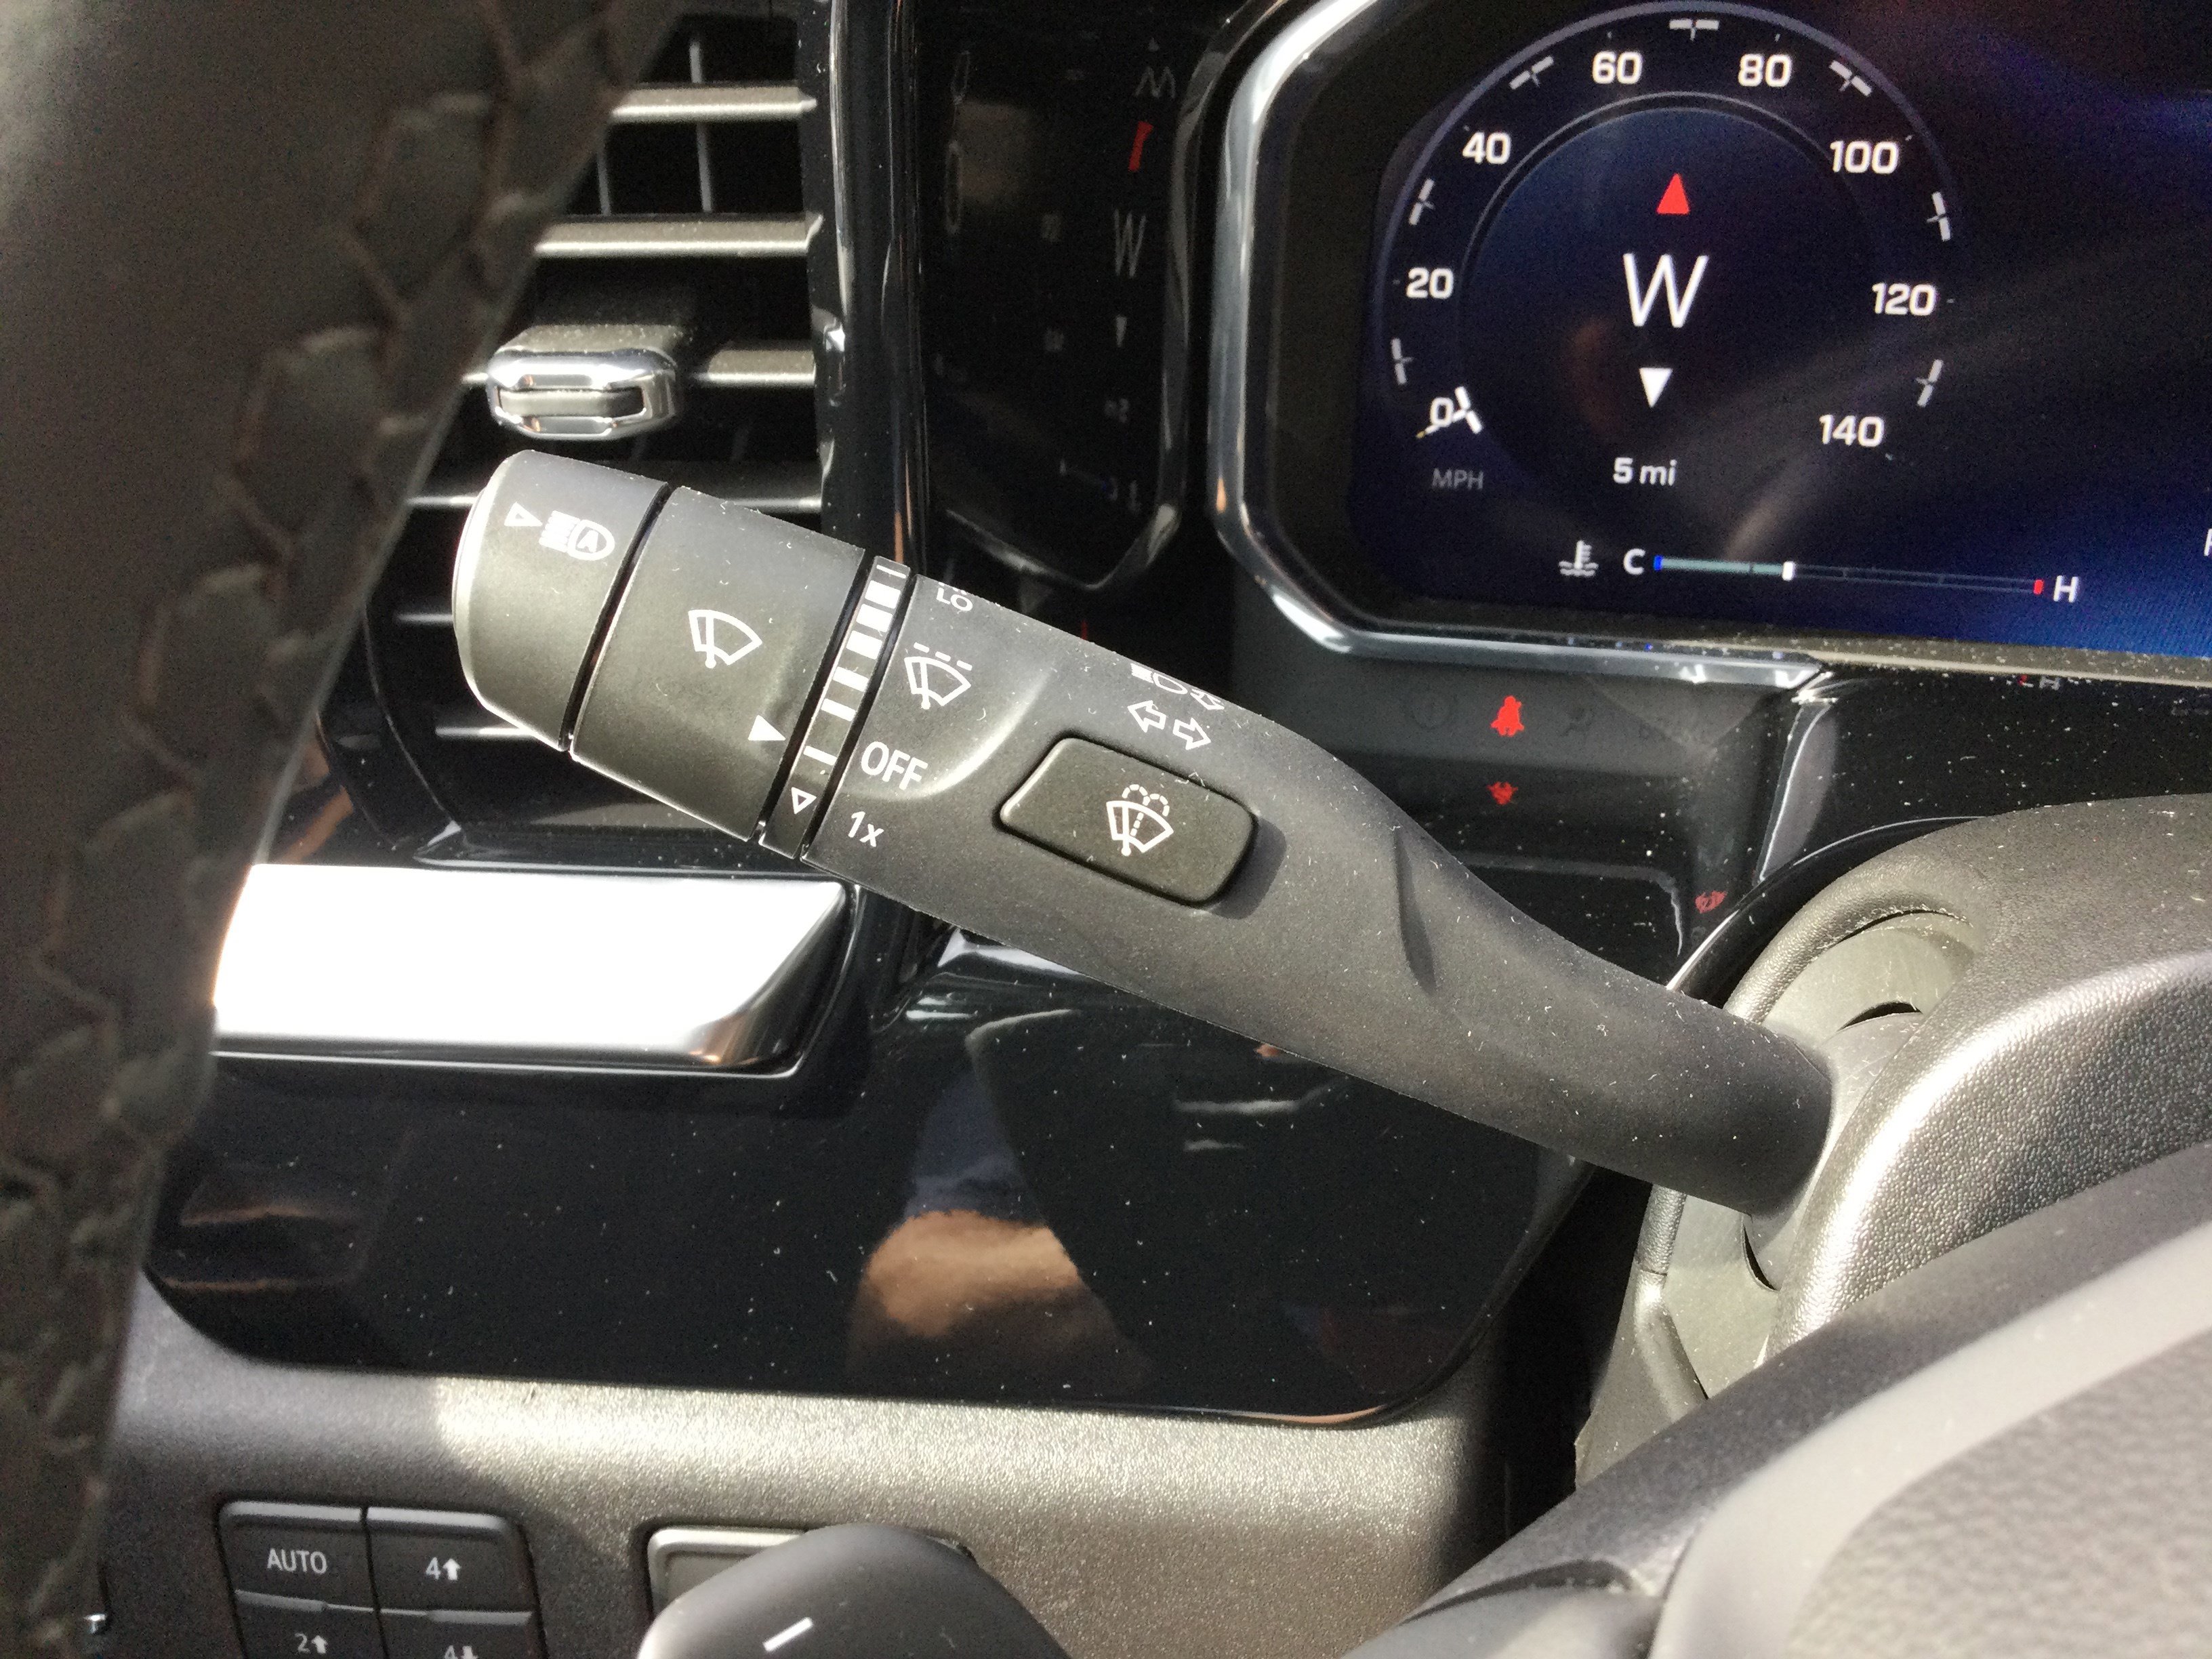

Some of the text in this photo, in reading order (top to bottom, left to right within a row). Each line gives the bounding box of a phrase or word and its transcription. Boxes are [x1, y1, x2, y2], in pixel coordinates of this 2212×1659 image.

[1592, 51, 1643, 85] 60
[1738, 53, 1793, 87] 80
[1462, 131, 1511, 165] 40
[1829, 140, 1900, 174] 100
[1406, 267, 1454, 300] 20
[1622, 252, 1709, 329] W
[1871, 282, 1937, 316] 120
[1430, 397, 1454, 428] 0
[1818, 413, 1885, 448] 140
[1431, 468, 1484, 491] MPH
[1613, 457, 1677, 487] 5 mi
[1622, 548, 1645, 575] C
[936, 587, 973, 611] LO
[2053, 575, 2080, 603] H
[860, 740, 928, 791] OFF
[847, 811, 884, 848] 1x
[267, 1548, 328, 1575] AUTO
[425, 1557, 442, 1580] 4
[294, 1632, 311, 1654] 2
